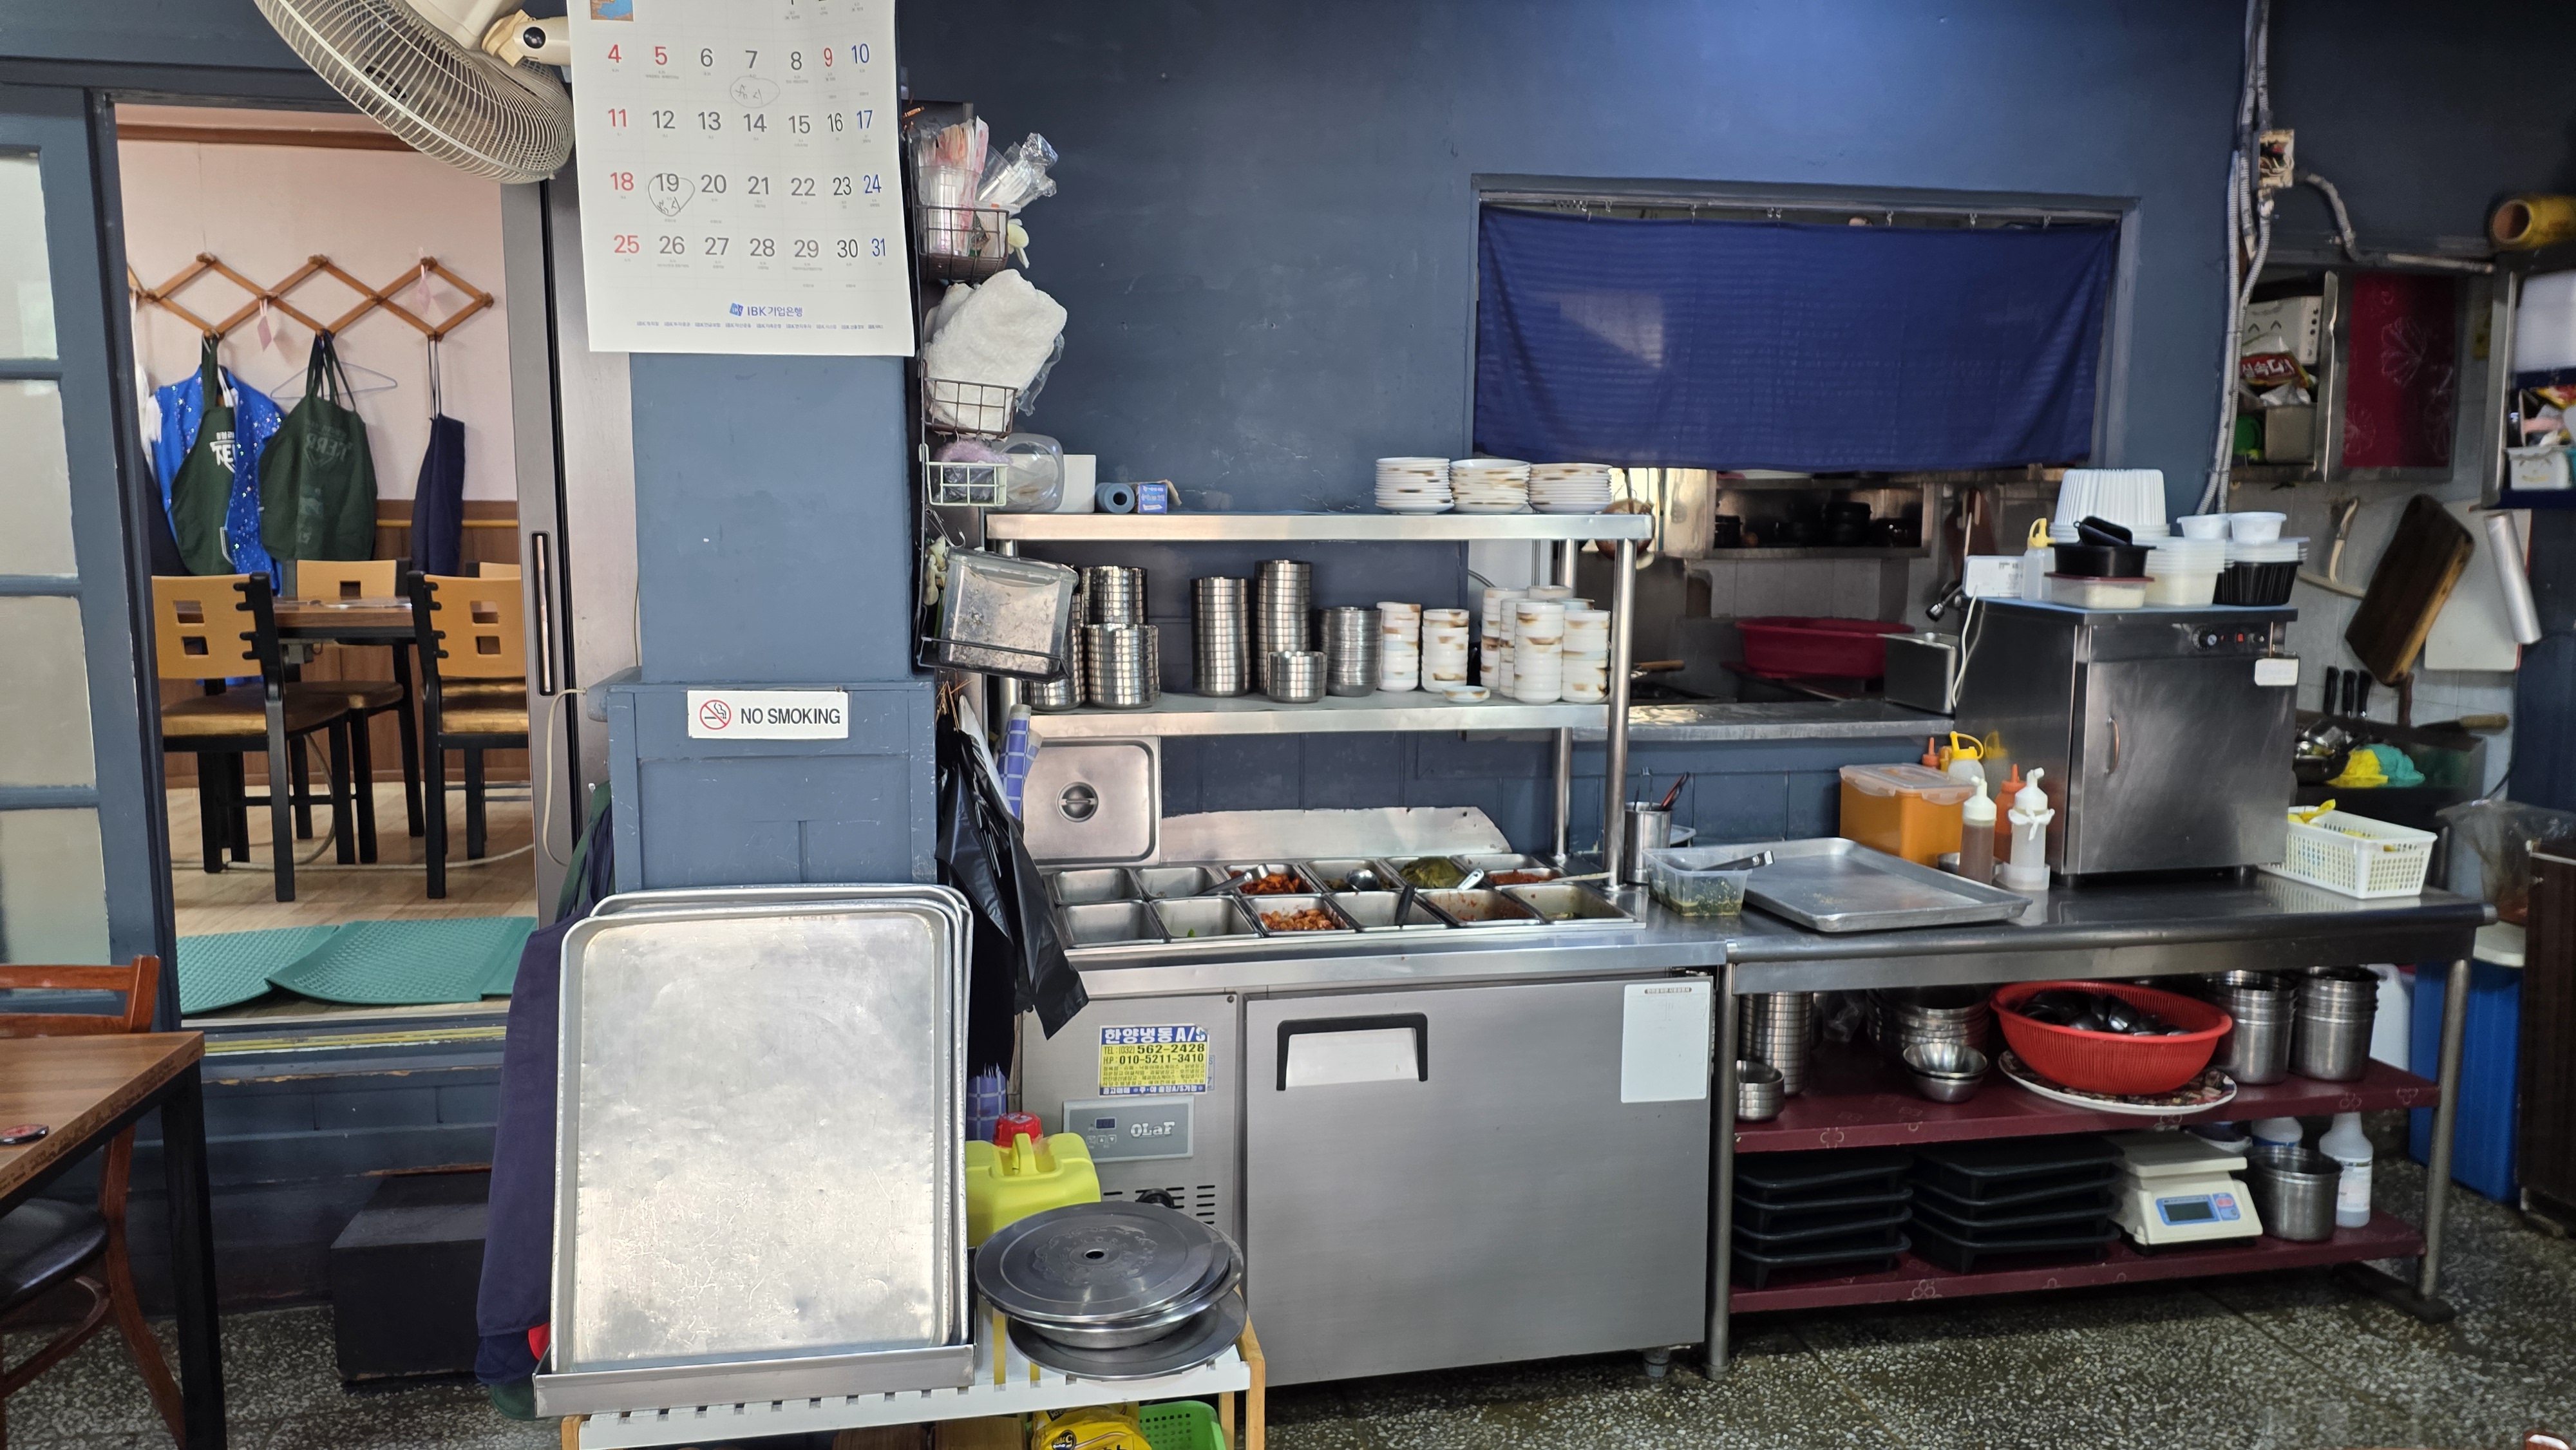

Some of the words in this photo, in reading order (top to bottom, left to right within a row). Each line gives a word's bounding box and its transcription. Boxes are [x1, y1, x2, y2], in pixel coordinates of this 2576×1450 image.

[608, 44, 621, 62] 4
[656, 46, 667, 65] 5
[701, 48, 713, 67] 6
[746, 50, 757, 68] 7
[791, 52, 802, 70] 8
[824, 48, 832, 67] 9
[852, 44, 869, 64] 10
[609, 109, 626, 127] 11
[653, 111, 675, 129] 12
[698, 112, 721, 130] 13
[744, 114, 766, 132] 14
[789, 115, 810, 133] 15
[828, 113, 842, 132] 16
[857, 110, 873, 129] 17
[611, 173, 634, 191] 18
[656, 174, 678, 191] 19
[701, 174, 726, 193] 20
[748, 176, 768, 194] 21
[791, 178, 815, 196] 22
[833, 176, 851, 195] 23
[864, 174, 882, 193] 24
[614, 235, 639, 253] 25
[659, 236, 685, 254] 26
[705, 237, 729, 255] 27
[750, 238, 775, 256] 28
[795, 240, 819, 258] 29
[837, 239, 858, 258] 30
[872, 238, 886, 256] 31
[209, 442, 236, 466] TE
[741, 708, 764, 724] NO
[767, 708, 840, 724] SMOKING
[1105, 1027, 1172, 1044] 한양냉동
[1119, 1053, 1204, 1064] 010-5211-3410
[1137, 1044, 1205, 1054] 562-2428
